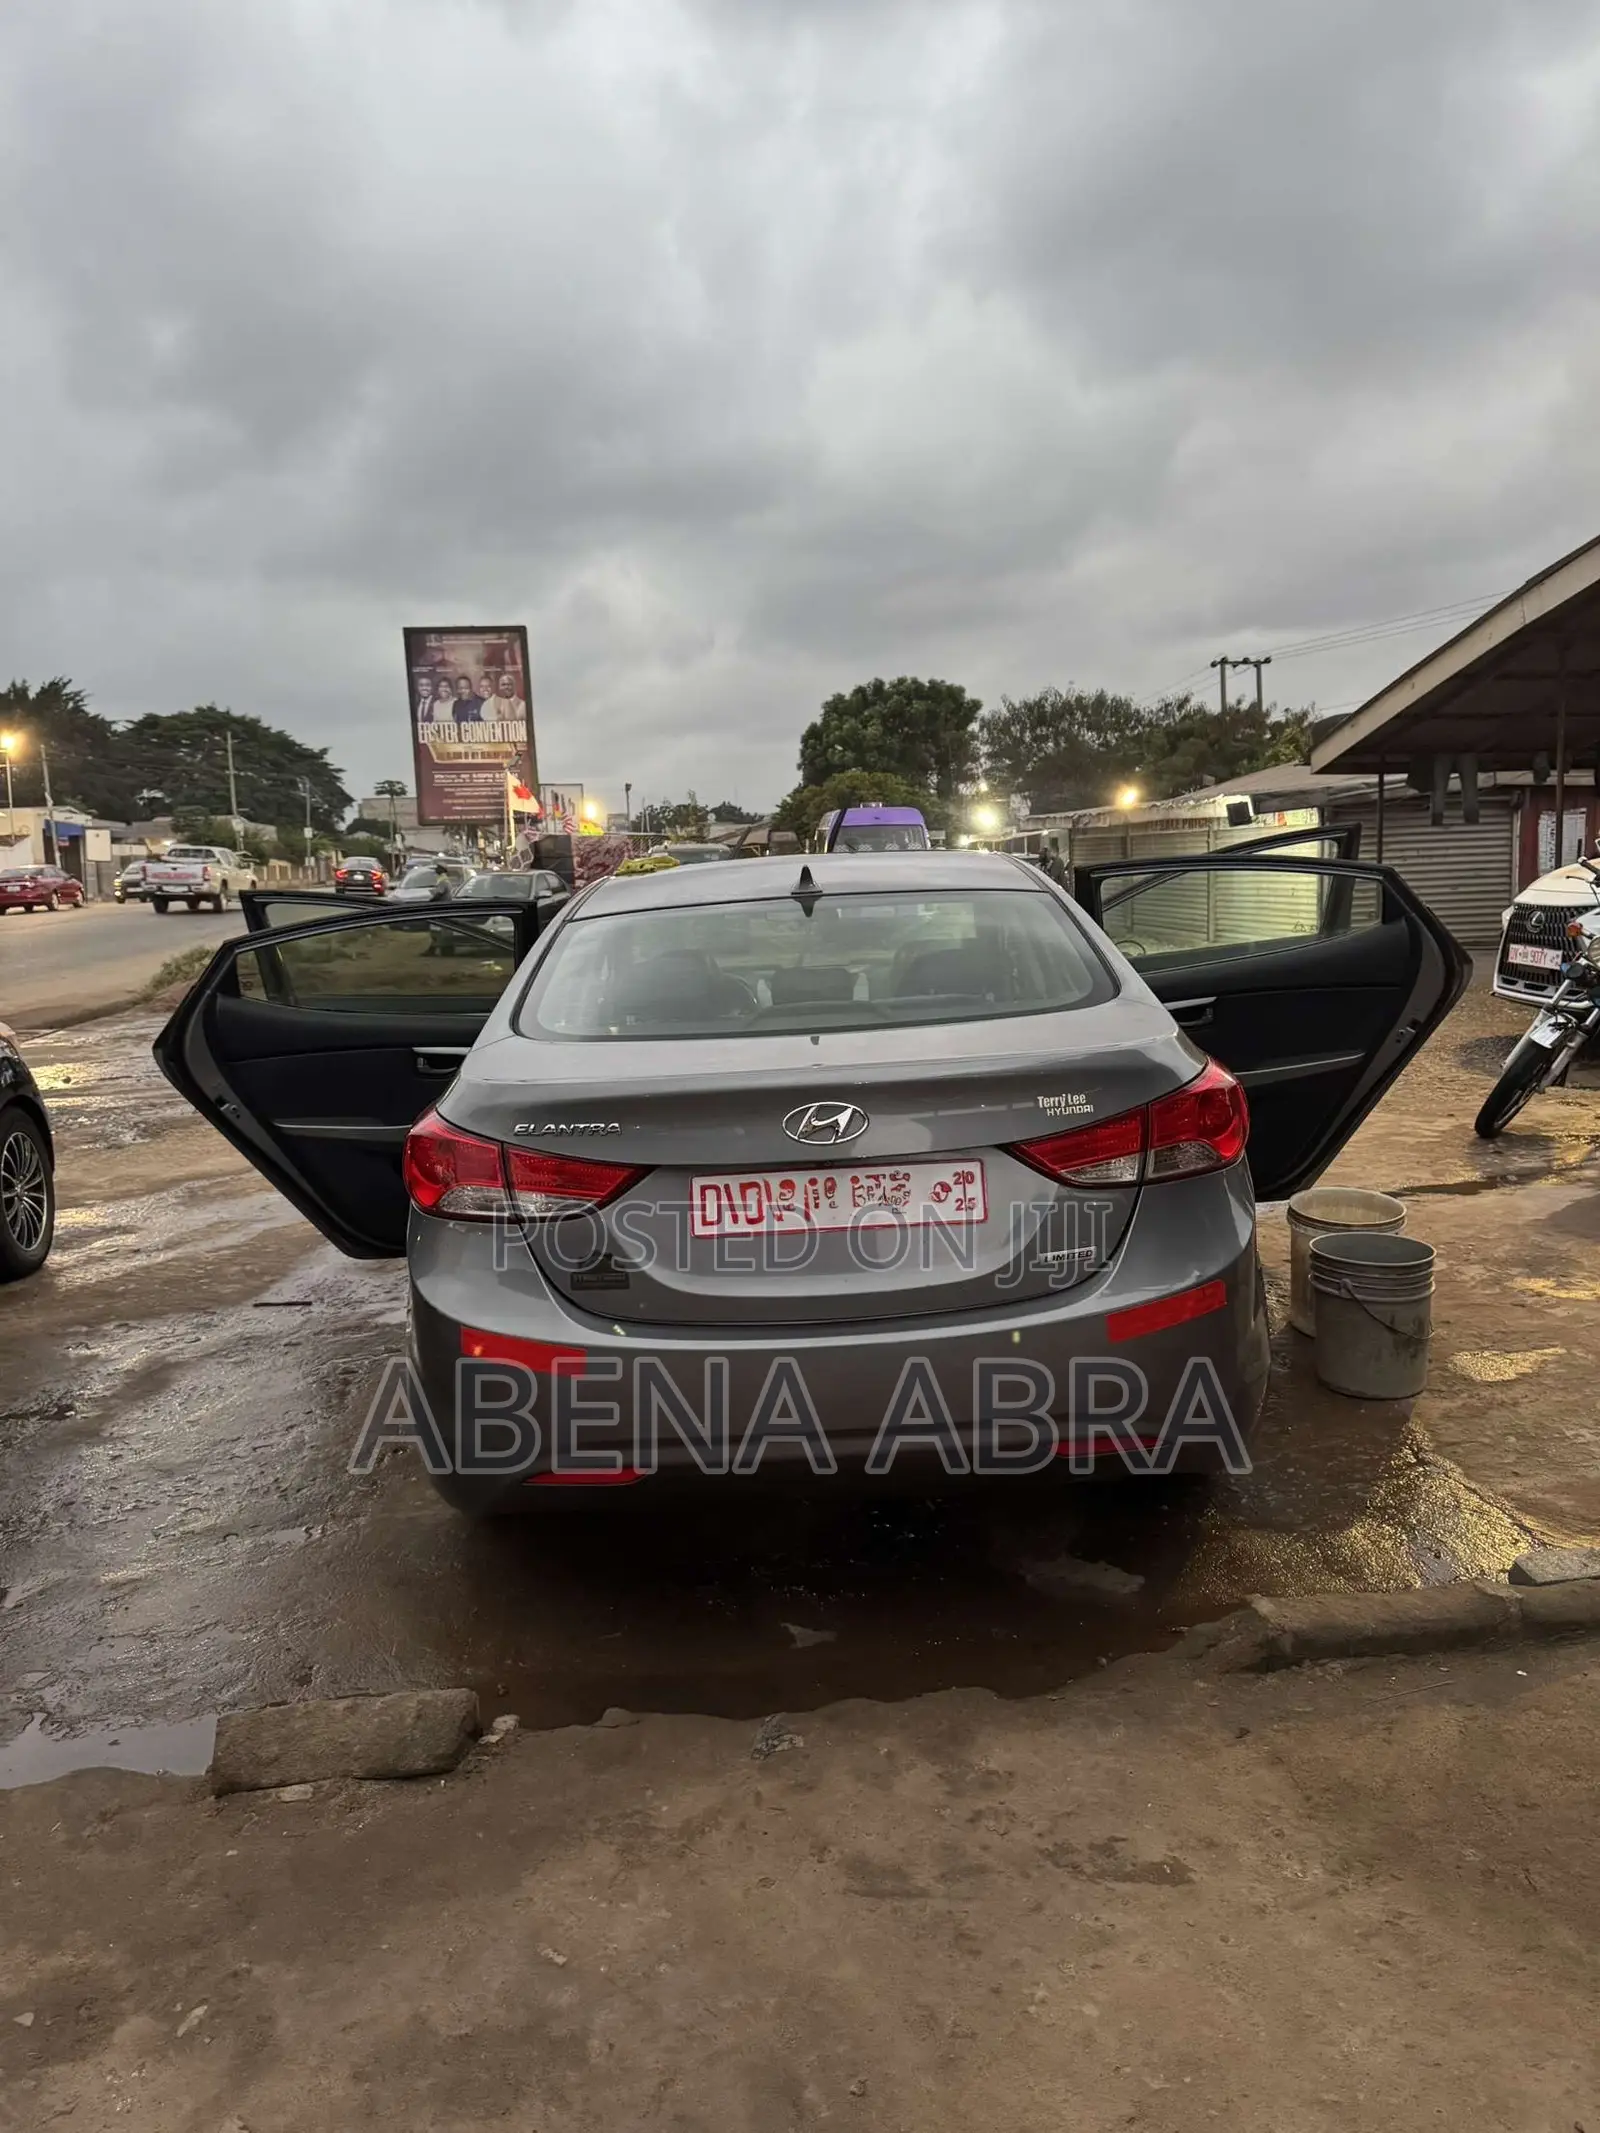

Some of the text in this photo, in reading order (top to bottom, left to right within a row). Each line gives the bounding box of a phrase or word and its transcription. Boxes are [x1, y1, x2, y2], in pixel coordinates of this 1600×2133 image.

[461, 720, 528, 743] CONVENTION
[1037, 1093, 1086, 1108] Terry Lee
[1046, 1104, 1094, 1116] HYUNDAI
[513, 1122, 622, 1136] ELANTRA
[1043, 1250, 1094, 1263] LIMITED
